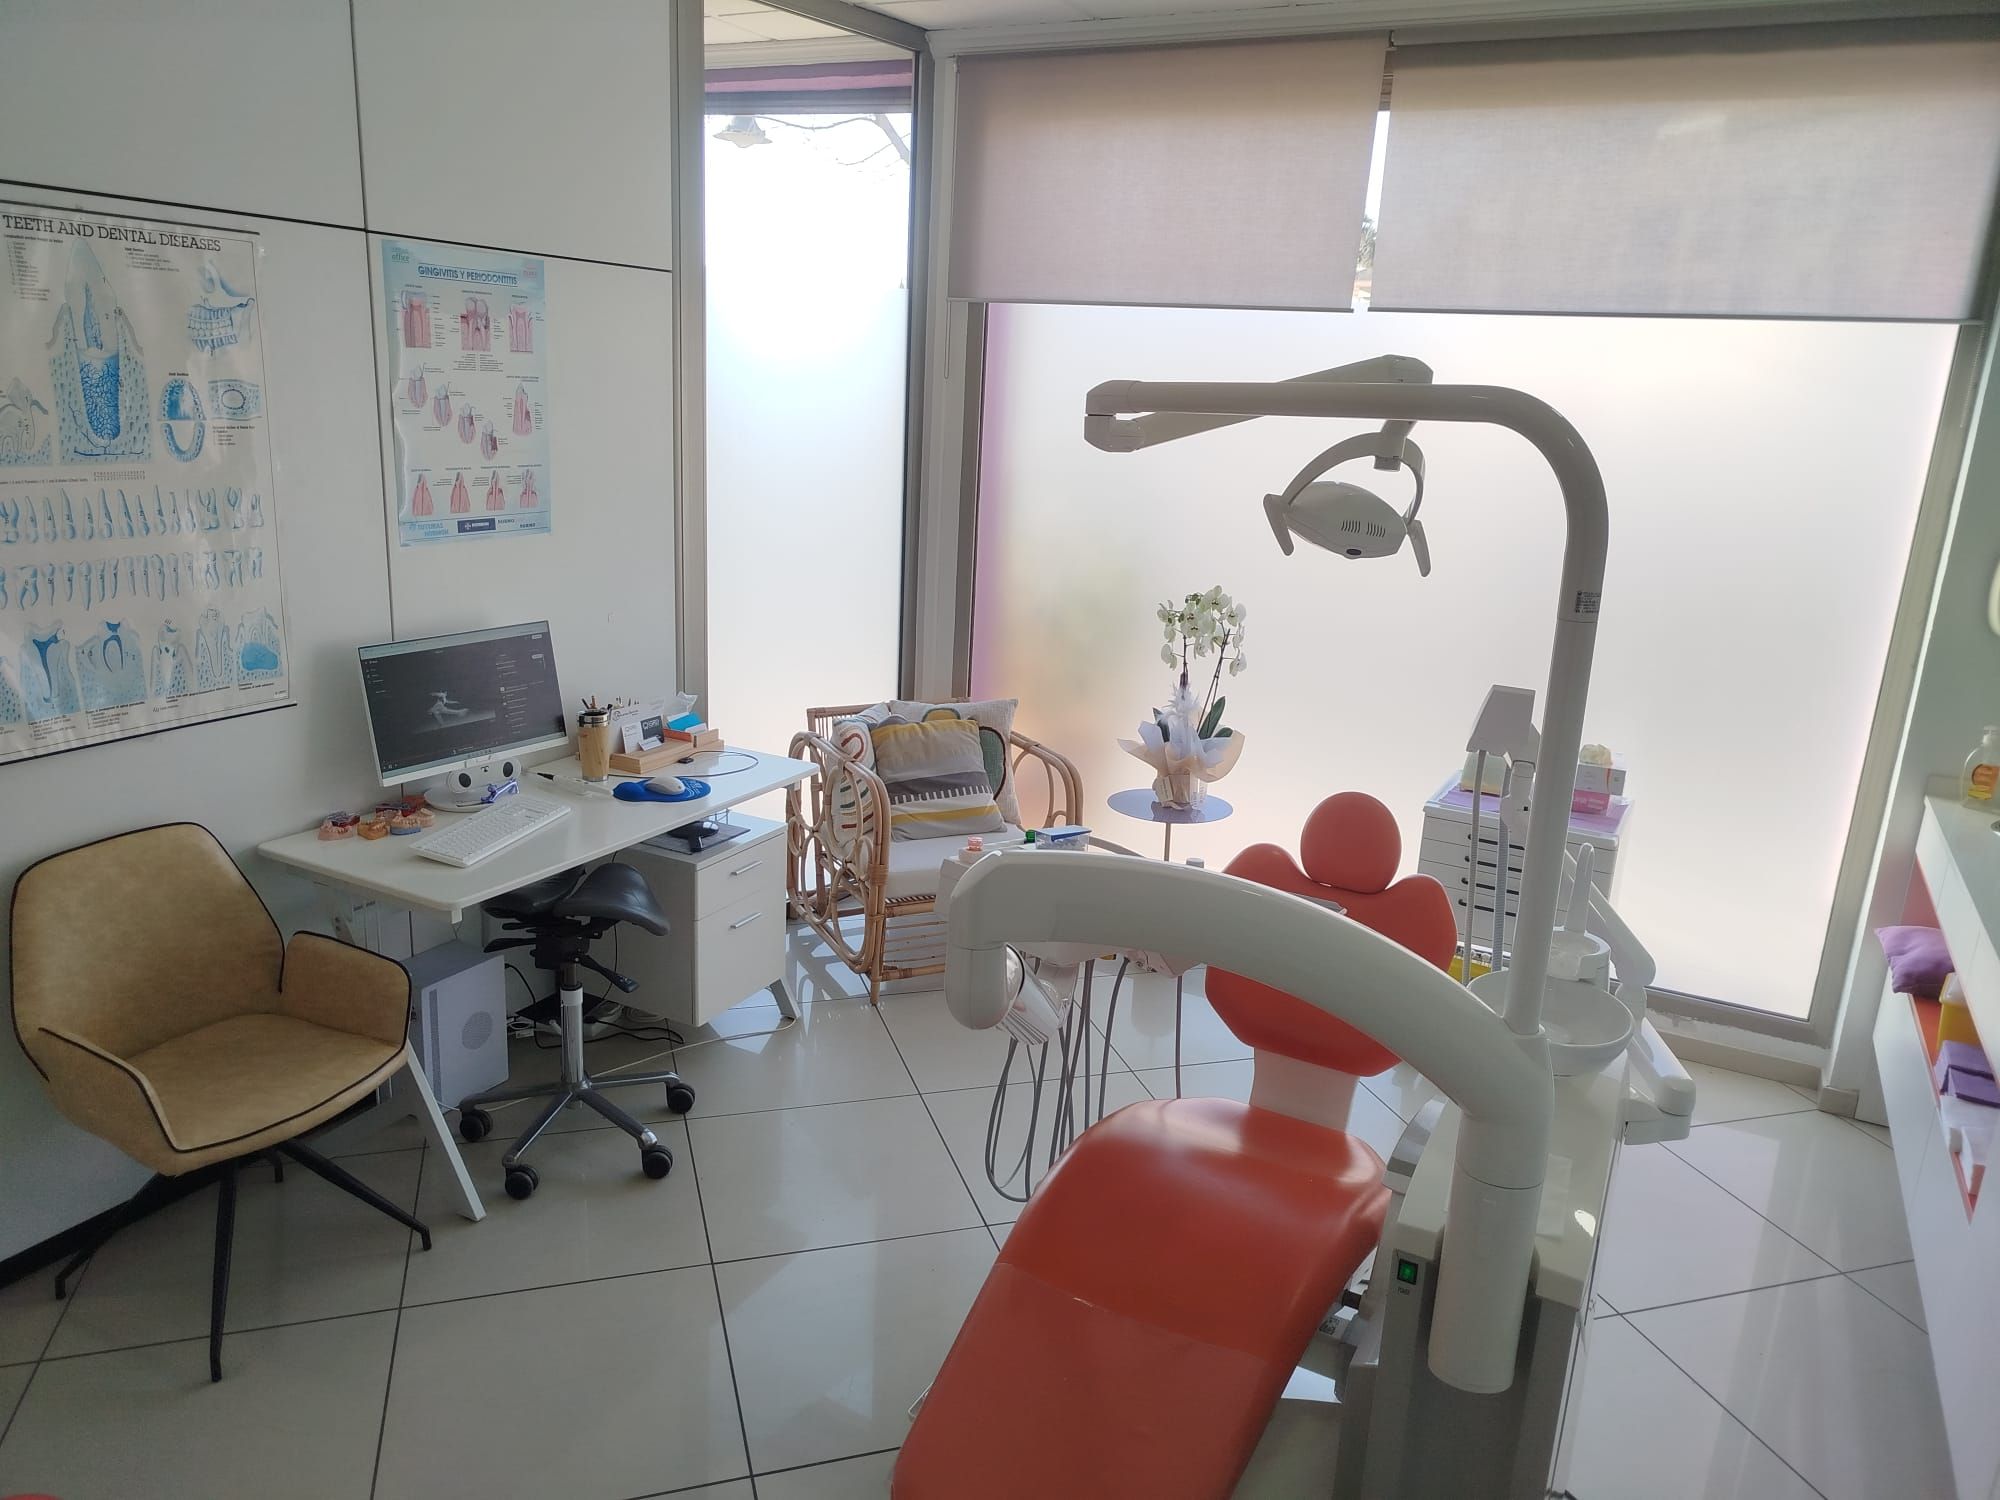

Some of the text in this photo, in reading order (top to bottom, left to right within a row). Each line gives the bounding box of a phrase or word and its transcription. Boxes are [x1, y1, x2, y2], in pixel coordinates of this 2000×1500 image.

[2, 214, 221, 251] TEETH AND DENTAL DISEASES
[418, 265, 459, 279] GINGIVITIS
[460, 270, 465, 280] Y
[466, 271, 518, 285] PERIODONTITIS
